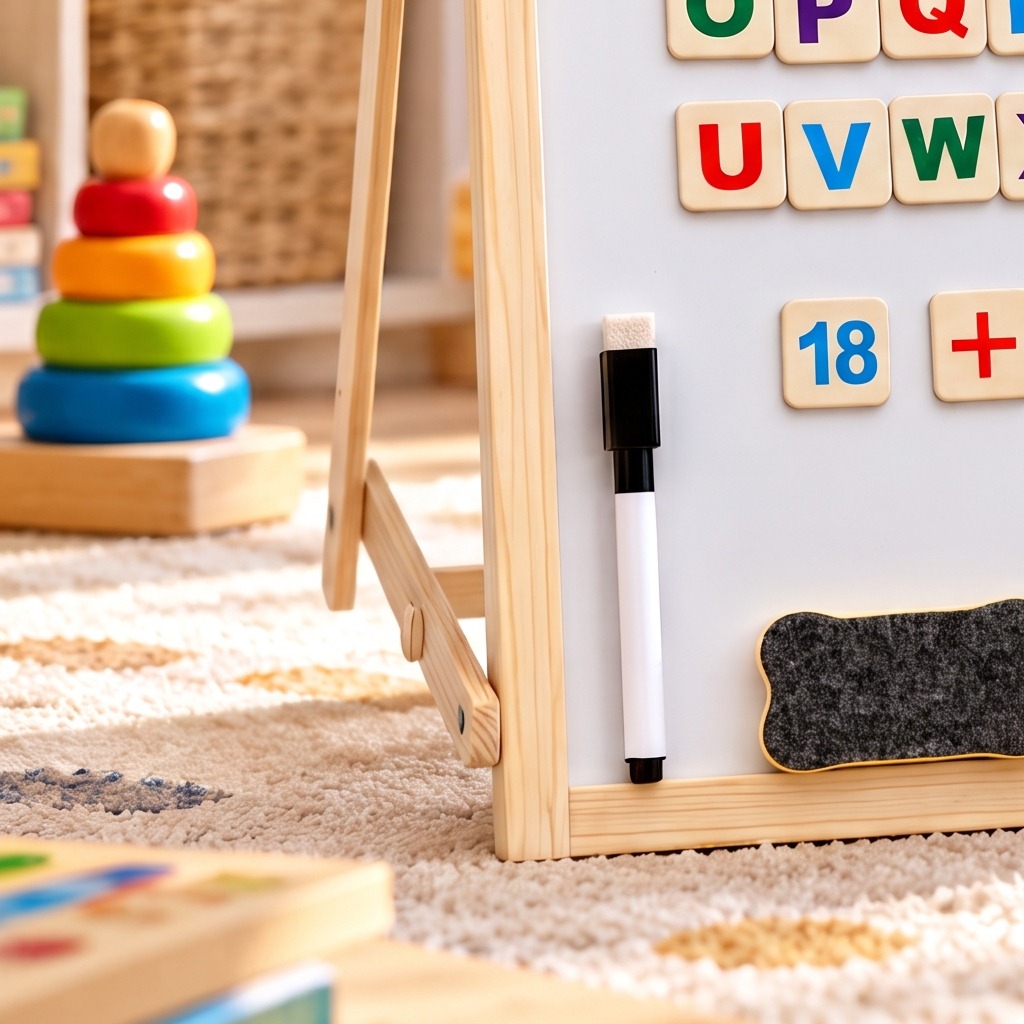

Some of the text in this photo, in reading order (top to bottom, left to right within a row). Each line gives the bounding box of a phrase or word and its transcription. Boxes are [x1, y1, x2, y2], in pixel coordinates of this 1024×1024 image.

[699, 122, 762, 190] U
[802, 122, 871, 190] V
[902, 115, 985, 181] W
[799, 320, 877, 385] 18
[952, 312, 1016, 378] +
